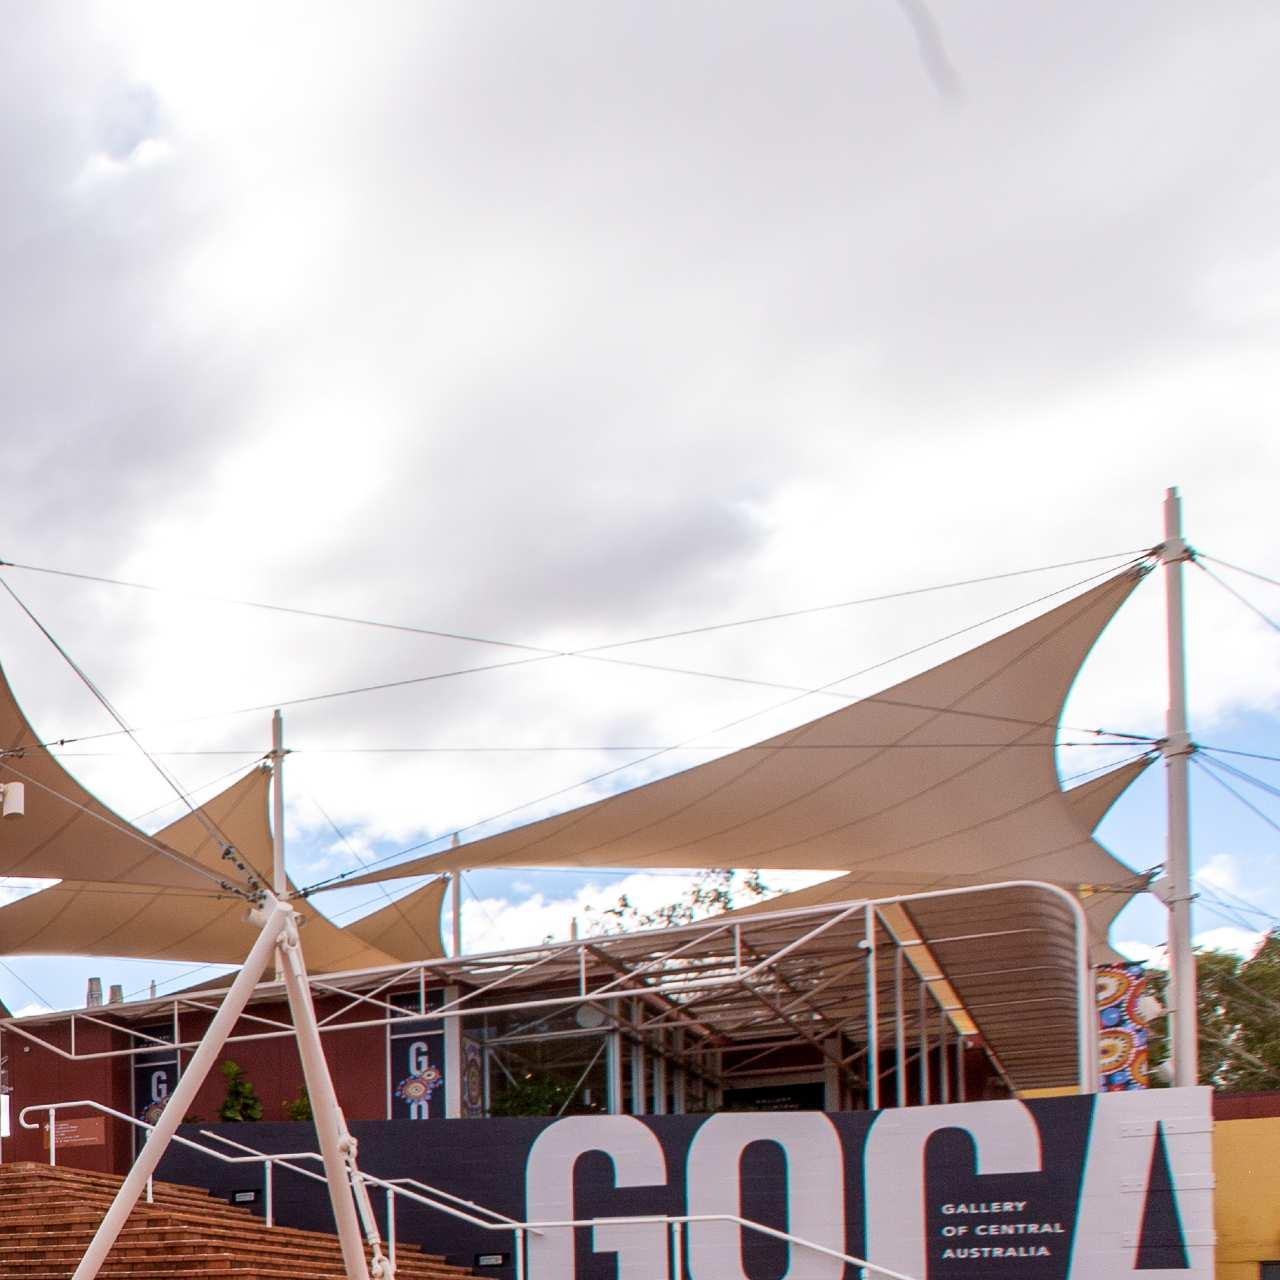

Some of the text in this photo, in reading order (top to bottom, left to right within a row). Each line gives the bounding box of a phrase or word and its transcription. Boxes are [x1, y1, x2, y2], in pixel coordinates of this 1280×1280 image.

[941, 1201, 1027, 1215] GALLERY
[941, 1222, 1066, 1237] OF CENTRAL
[941, 1245, 1052, 1260] AUSTRALIA
